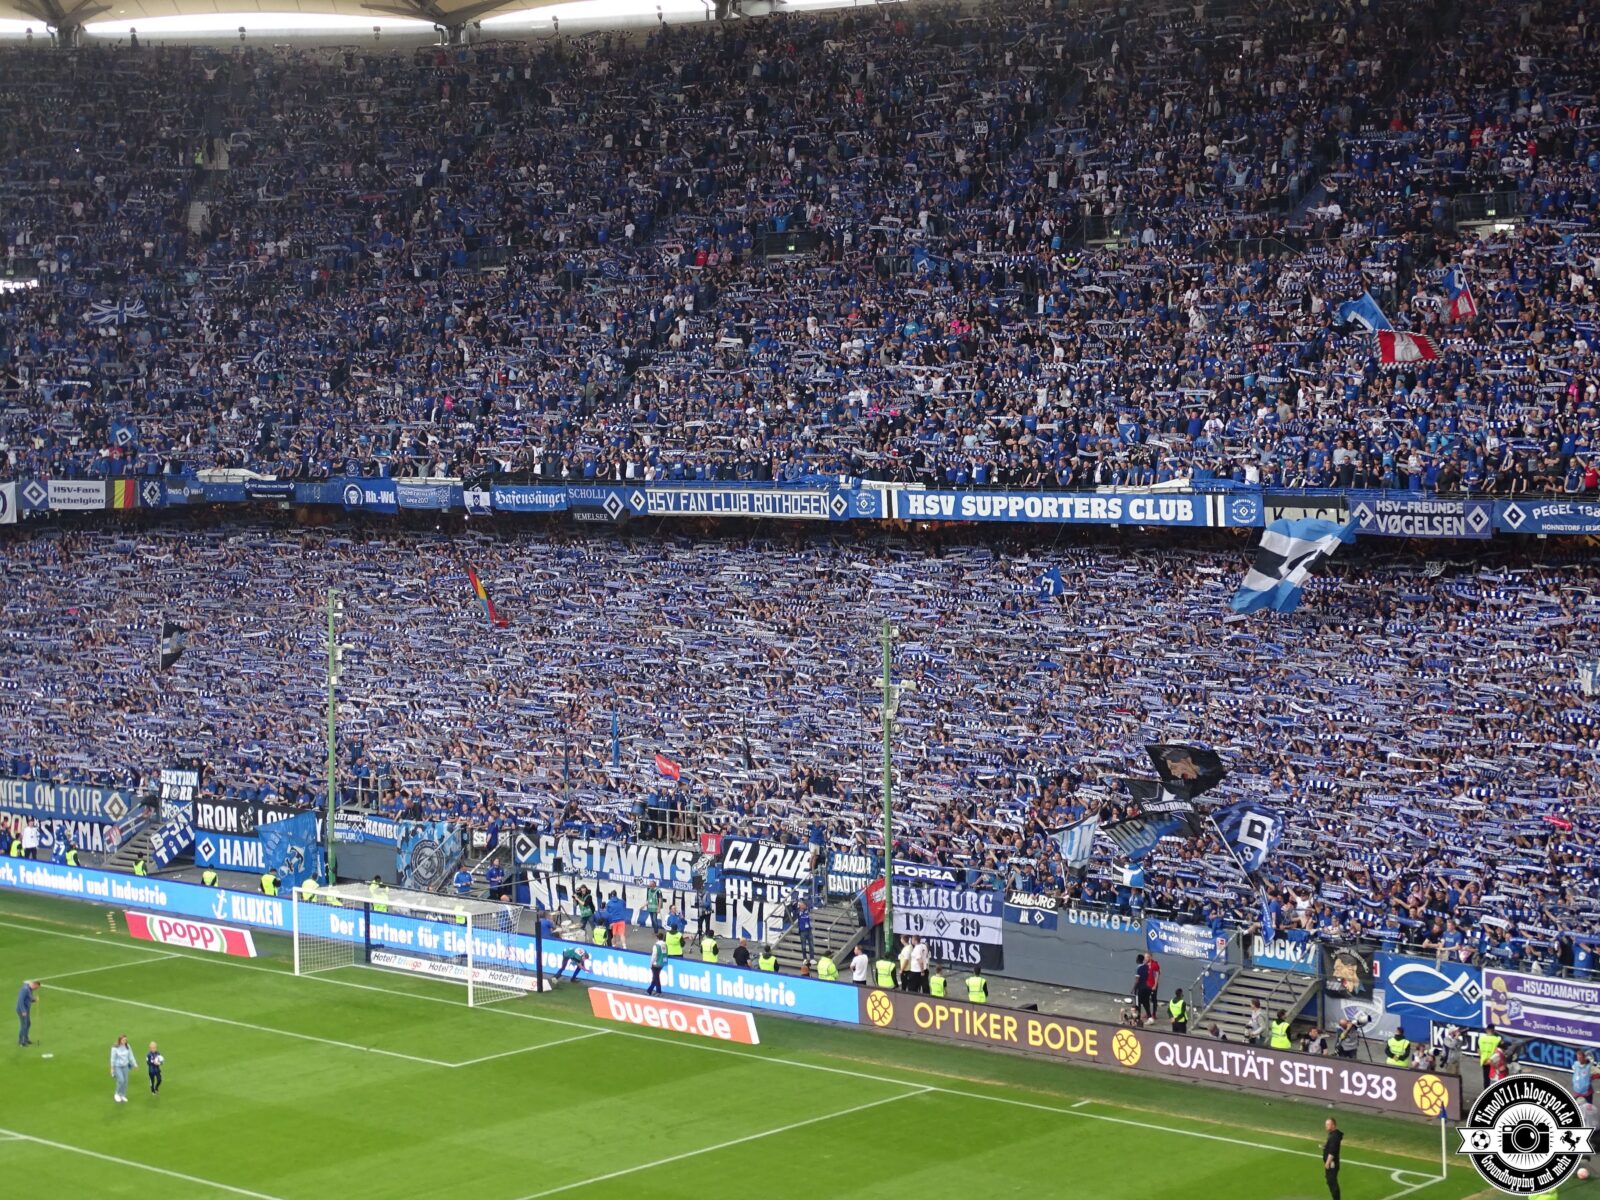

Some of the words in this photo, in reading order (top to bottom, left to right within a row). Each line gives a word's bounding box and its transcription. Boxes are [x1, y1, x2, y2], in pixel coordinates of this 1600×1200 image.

[53, 486, 101, 494] HSV-Fans
[568, 488, 607, 499] SCHOLLI
[647, 492, 675, 511] HSV
[680, 493, 708, 512] FAN
[711, 493, 750, 513] CLUB
[754, 493, 830, 515] ROTHOSEN
[908, 494, 955, 516] HSV
[962, 496, 1122, 519] SUPPORTERS
[1129, 498, 1194, 521] CLUB
[1375, 500, 1464, 513] HSV-FREUNDE
[1532, 503, 1574, 519] PEGEL
[1376, 514, 1465, 536] VØGELSEN
[34, 784, 55, 812] ON
[58, 786, 103, 817] TOUR
[540, 834, 693, 882] CASTAWAYS
[723, 840, 812, 879] CLIQUE
[19, 864, 84, 893] Fachhandel
[86, 877, 109, 897] und
[112, 879, 167, 906] Industrie
[893, 865, 956, 882] FORZA
[231, 895, 284, 926] KLUXEN
[892, 886, 994, 915] HAMBURG
[1009, 892, 1057, 909] HAMBURG
[905, 912, 924, 932] 19
[960, 917, 981, 938] 89
[329, 913, 355, 936] Der
[417, 926, 440, 949] für
[678, 971, 711, 993] und
[716, 973, 796, 1007] Industrie
[373, 952, 397, 963] Hotel?
[428, 962, 453, 974] Hotel?
[488, 969, 514, 983] Hotel?
[606, 992, 732, 1040] buero.de
[913, 1001, 1018, 1043] OPTIKER
[1027, 1019, 1099, 1056] BODE
[1154, 1041, 1275, 1081] QUALITÄT
[1279, 1060, 1334, 1091] SEIT
[1339, 1070, 1397, 1101] 1938
